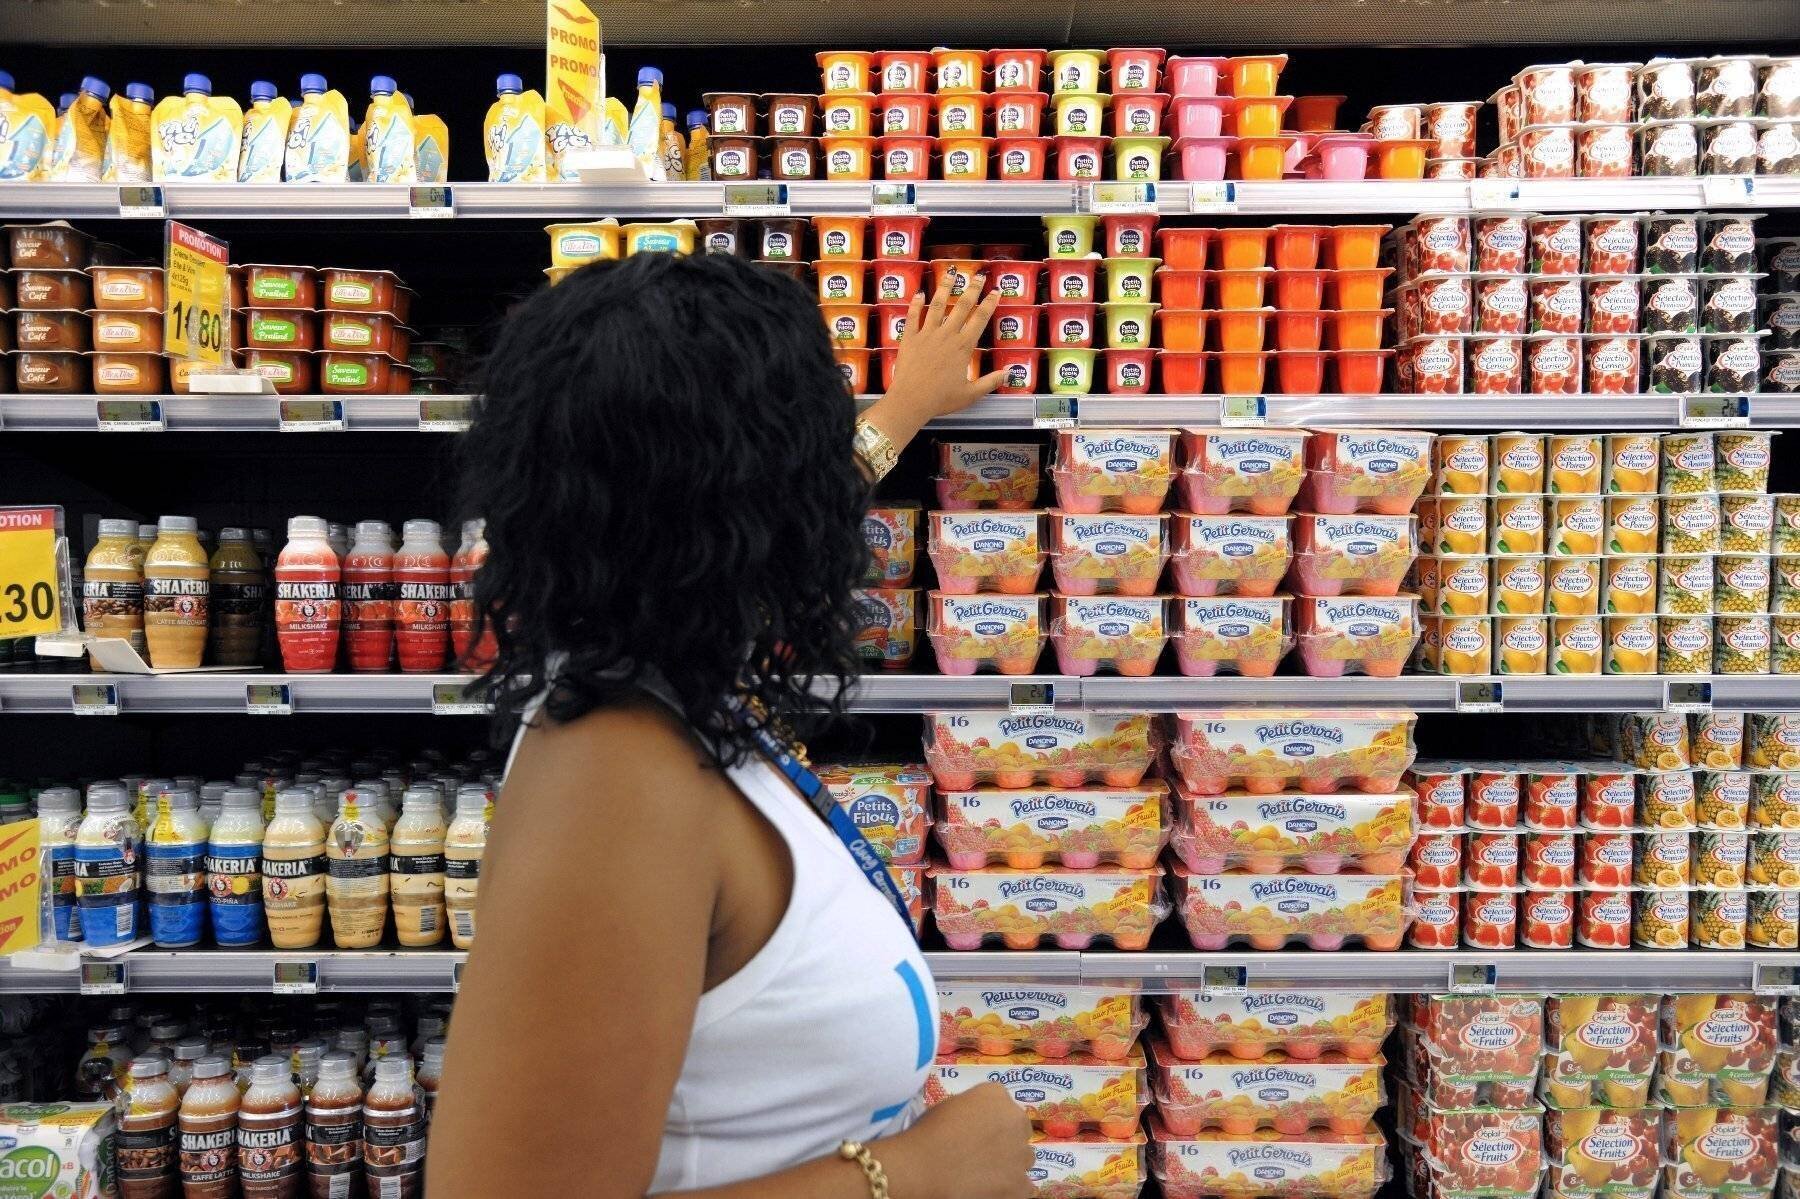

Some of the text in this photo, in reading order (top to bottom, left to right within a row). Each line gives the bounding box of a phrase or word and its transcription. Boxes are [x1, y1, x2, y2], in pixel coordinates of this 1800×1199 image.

[551, 27, 597, 51] PROMO
[550, 55, 596, 77] PROMO
[179, 229, 222, 259] PROMOTION
[20, 249, 37, 257] Café
[260, 280, 287, 288] Saveur
[29, 292, 48, 300] Café
[260, 289, 288, 297] Praliné
[260, 323, 287, 331] Saveur
[260, 332, 287, 340] Praliné
[24, 365, 50, 373] Saveur
[27, 373, 45, 382] Café
[332, 375, 360, 383] Praliné
[1083, 440, 1160, 459] Petit Gervais
[1219, 439, 1292, 459] Petit Gervais
[1559, 455, 1591, 463] Sélection
[1568, 461, 1587, 469] Poires
[943, 517, 953, 525] 8
[953, 518, 1026, 539] Petit Gervais
[1509, 576, 1540, 584] Sélection
[278, 584, 335, 598] SHAKERIA
[401, 584, 456, 598] SHAKERIA
[1515, 582, 1534, 590] Poires
[956, 601, 1029, 621] Petit Gervais
[1328, 603, 1400, 621] Petit Gervais
[976, 624, 1004, 632] DANONE
[1516, 641, 1535, 649] Poires
[950, 716, 969, 727] 16
[1000, 715, 1084, 735] Petit Gervais
[1206, 723, 1225, 733] 16
[1257, 722, 1343, 742] Petit Gervais
[858, 801, 891, 811] Petits
[854, 813, 895, 824] Filous
[1201, 879, 1220, 889] 16
[1253, 879, 1336, 898] Petit Gervais
[1535, 907, 1566, 916] Sélection
[1469, 1025, 1513, 1036] Sélection
[1587, 1024, 1630, 1034] Sélection
[1704, 1022, 1749, 1033] Sélection
[1479, 1036, 1507, 1045] Fruits
[1597, 1034, 1624, 1045] Fruits
[1715, 1033, 1742, 1042] Fruits
[1184, 1069, 1203, 1079] 16
[1234, 1068, 1315, 1087] Petit Gervais
[1472, 1141, 1514, 1151] Sélection
[1481, 1152, 1508, 1161] Fruits
